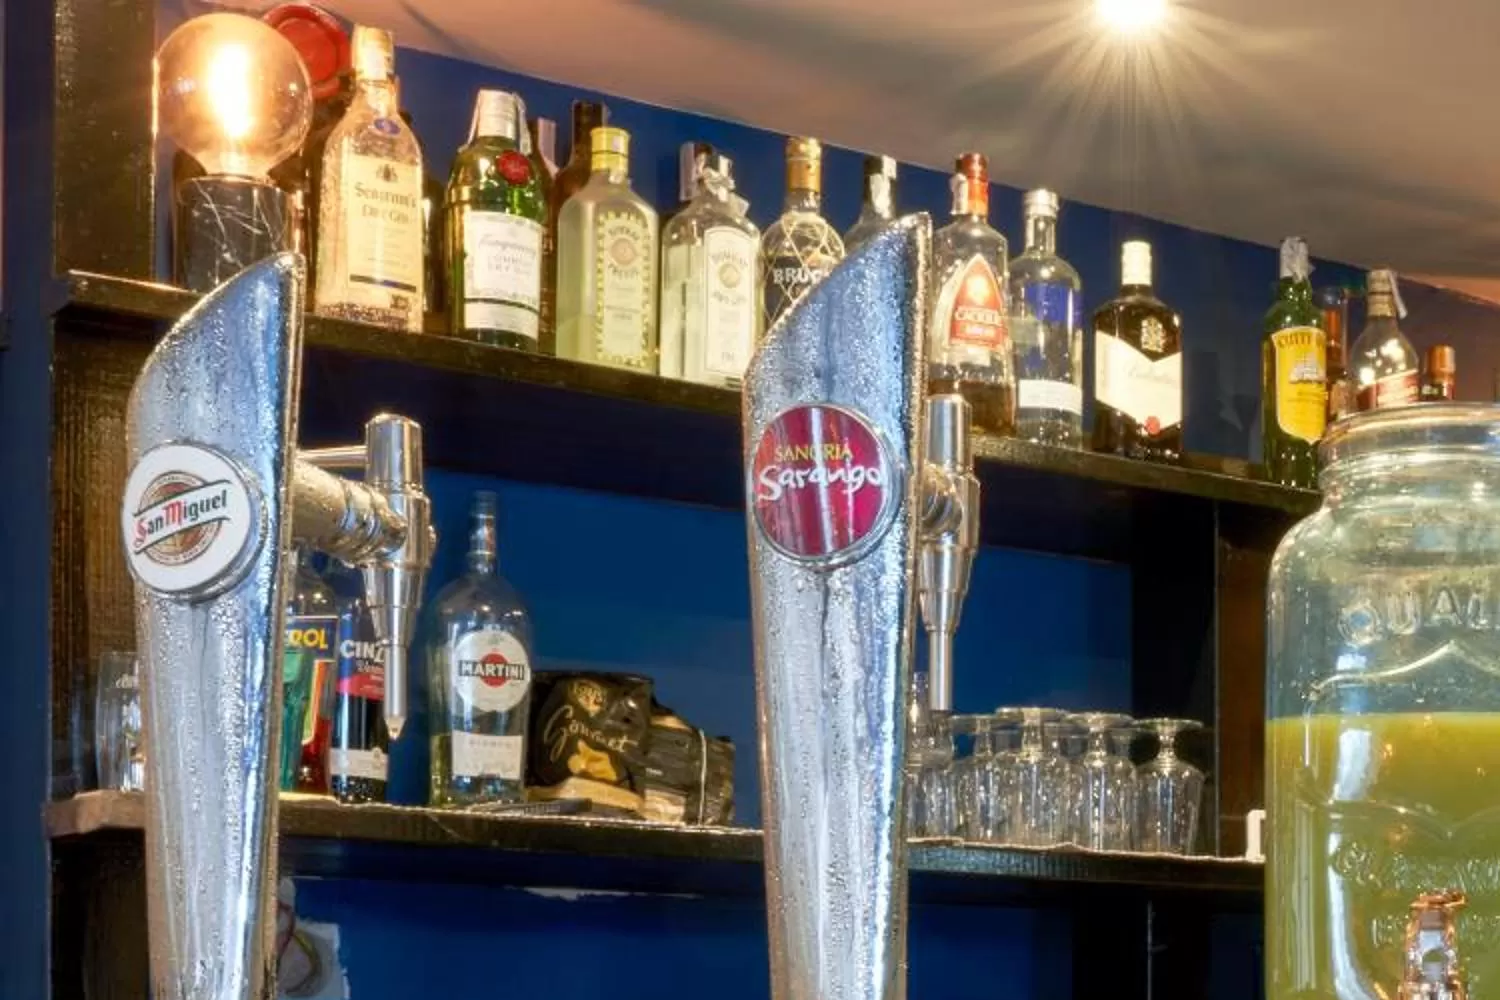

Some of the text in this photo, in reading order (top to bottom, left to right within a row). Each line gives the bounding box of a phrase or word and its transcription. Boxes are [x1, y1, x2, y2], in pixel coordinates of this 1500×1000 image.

[773, 267, 824, 285] BRUG
[288, 628, 330, 650] ROL
[340, 639, 386, 664] CINZ
[459, 660, 525, 681] MARTINI
